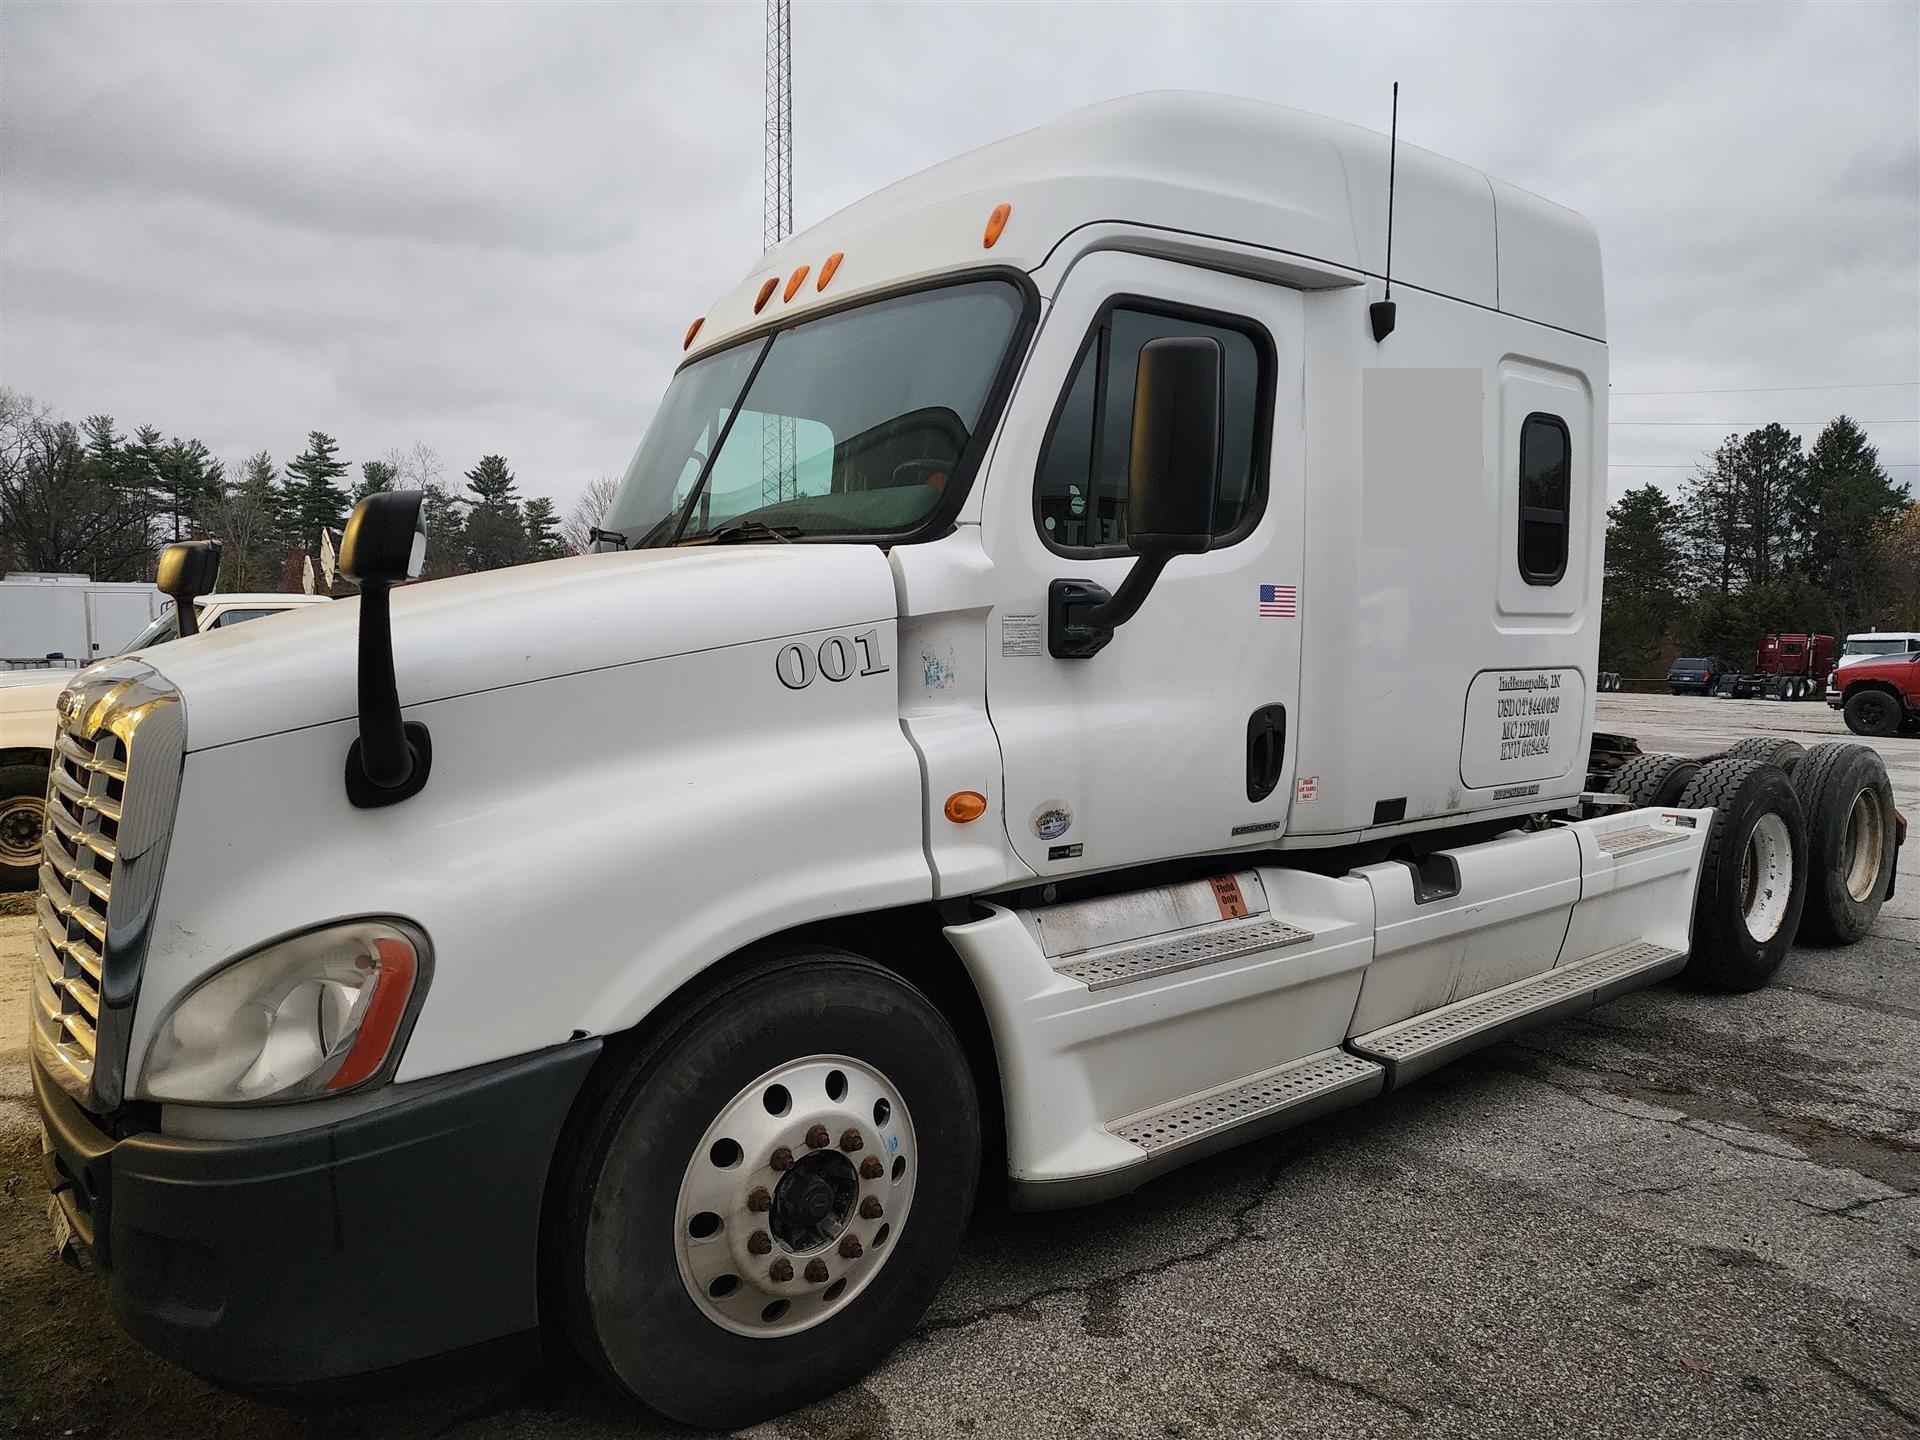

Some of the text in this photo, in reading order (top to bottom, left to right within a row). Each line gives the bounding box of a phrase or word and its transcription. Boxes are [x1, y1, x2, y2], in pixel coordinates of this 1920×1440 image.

[776, 629, 890, 690] 001
[1499, 674, 1561, 693] Indianapolis, IN
[1498, 697, 1528, 718] USDOT
[1502, 720, 1518, 740] MC
[1216, 882, 1236, 894] Fluid
[1222, 895, 1239, 905] Only
